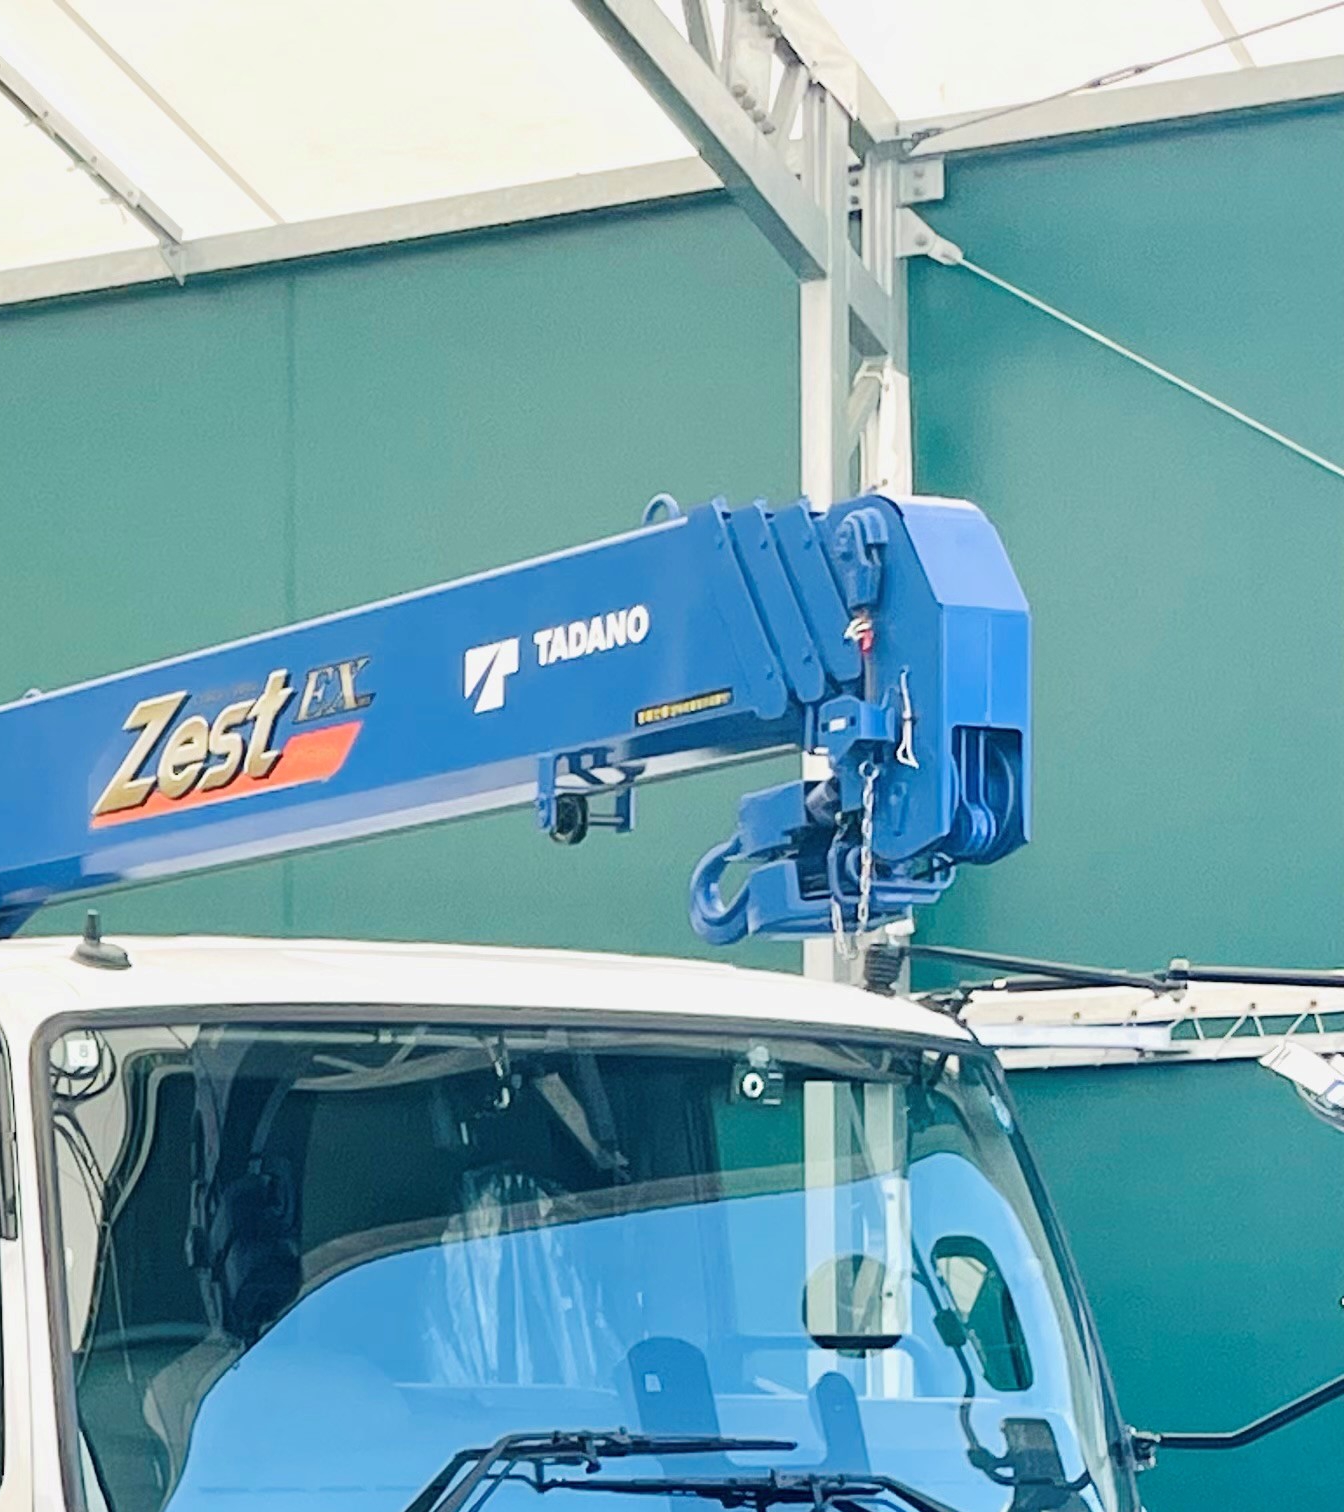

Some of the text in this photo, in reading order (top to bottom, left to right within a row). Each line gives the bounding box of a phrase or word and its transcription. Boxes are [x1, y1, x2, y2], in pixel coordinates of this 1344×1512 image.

[533, 604, 650, 666] TADANO
[92, 656, 376, 815] Zest EX
